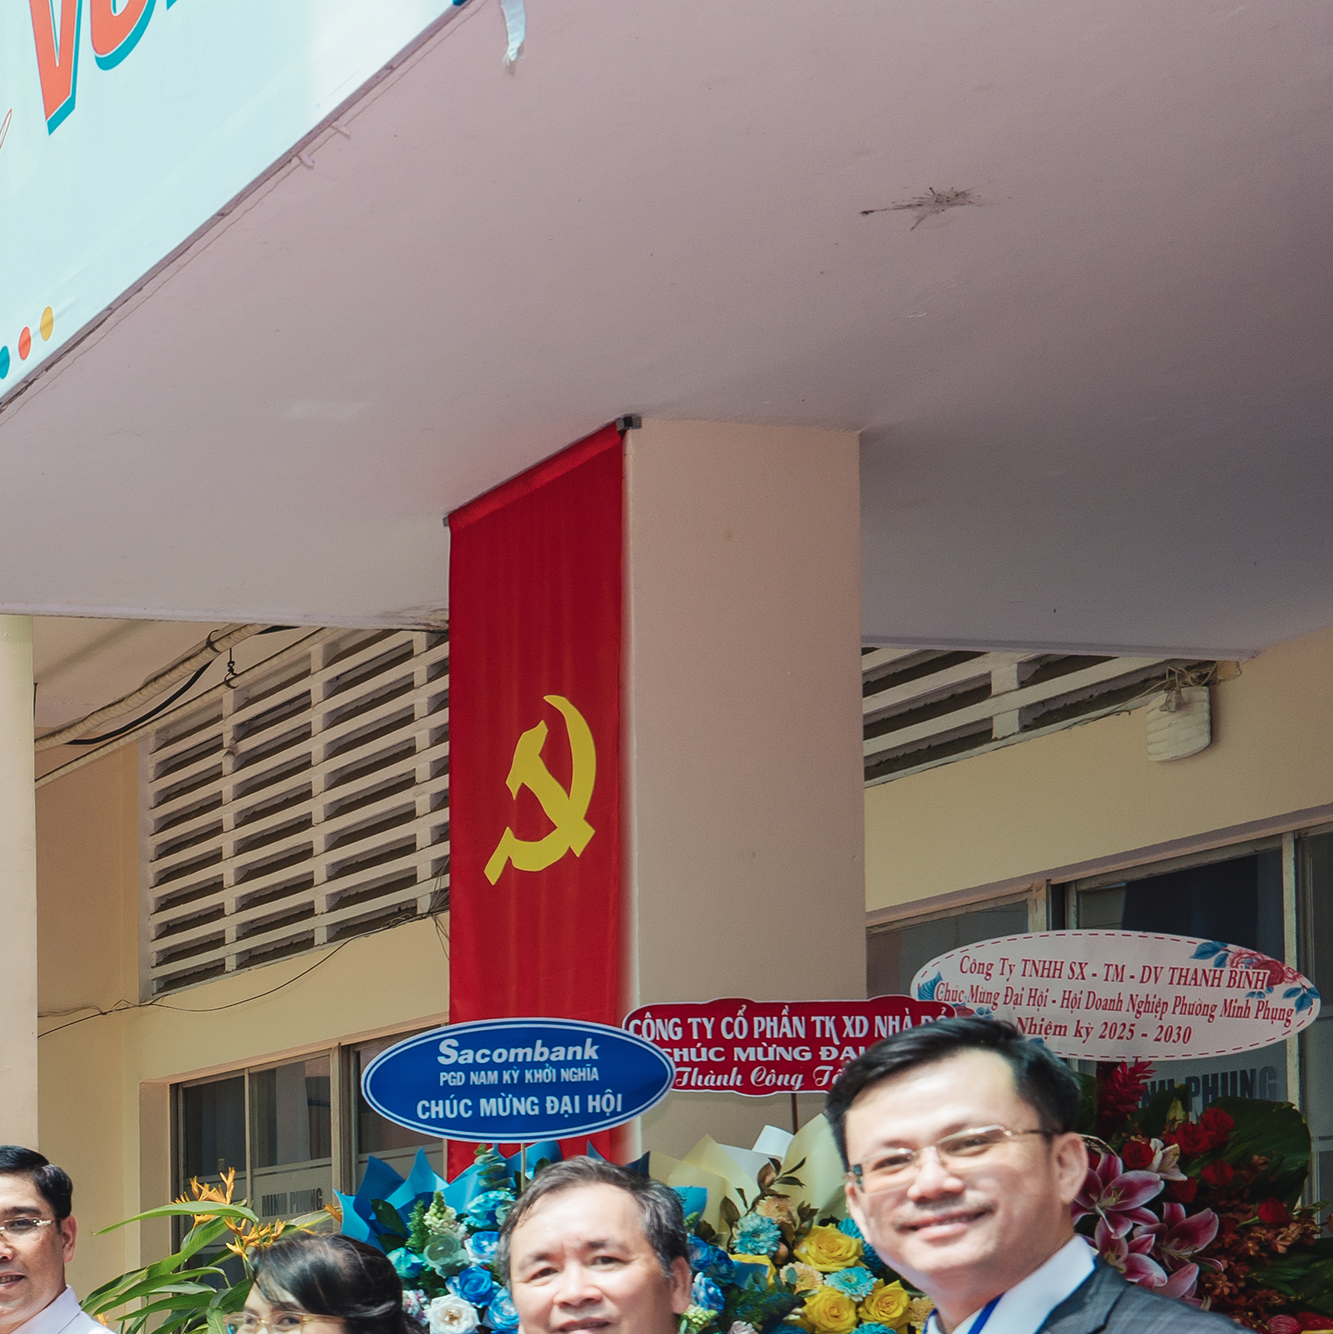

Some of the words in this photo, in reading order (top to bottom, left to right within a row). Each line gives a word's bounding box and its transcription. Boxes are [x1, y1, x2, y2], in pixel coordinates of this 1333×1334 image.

[959, 956, 994, 981] Công
[999, 957, 1016, 982] Ty
[1021, 958, 1064, 979] TNHH
[1068, 961, 1088, 981] SX
[1103, 963, 1126, 983] TM
[1139, 965, 1164, 984] DV
[1168, 966, 1223, 988] THANH
[935, 982, 965, 1003] Chúc
[1004, 986, 1025, 1011] Đại
[1027, 987, 1050, 1012] Hội
[1060, 989, 1083, 1014] Hội
[1085, 990, 1123, 1012] Doanh
[1126, 993, 1169, 1021] Nghiệp
[1172, 996, 1218, 1023] Phường
[1220, 998, 1251, 1019] Minh
[1254, 1000, 1294, 1028] Phụng
[629, 1011, 683, 1041] CÔNG
[687, 1017, 715, 1039] TY
[720, 1004, 749, 1040] CỔ
[753, 1005, 806, 1039] PHẦN
[811, 1015, 841, 1045] TK
[842, 1015, 869, 1038] XD
[874, 1007, 913, 1038] NHÀ
[1016, 1016, 1068, 1040] Nhiệm
[1073, 1019, 1095, 1044] kỳ
[1098, 1021, 1136, 1041] 2025
[1154, 1025, 1193, 1045] 2030
[437, 1038, 600, 1065] Sacombank
[733, 1041, 813, 1062] MỪNG
[439, 1071, 465, 1086] PGD
[469, 1070, 498, 1084] NAM
[503, 1066, 520, 1084] KỲ
[525, 1063, 558, 1083] KHỞI
[560, 1063, 599, 1083] NGHĨA
[675, 1066, 744, 1087] Thành
[750, 1066, 804, 1090] Công
[416, 1094, 473, 1120] CHÚC
[479, 1092, 539, 1117] MỪNG
[545, 1095, 581, 1119] ĐẠI
[587, 1088, 623, 1117] HỘI
